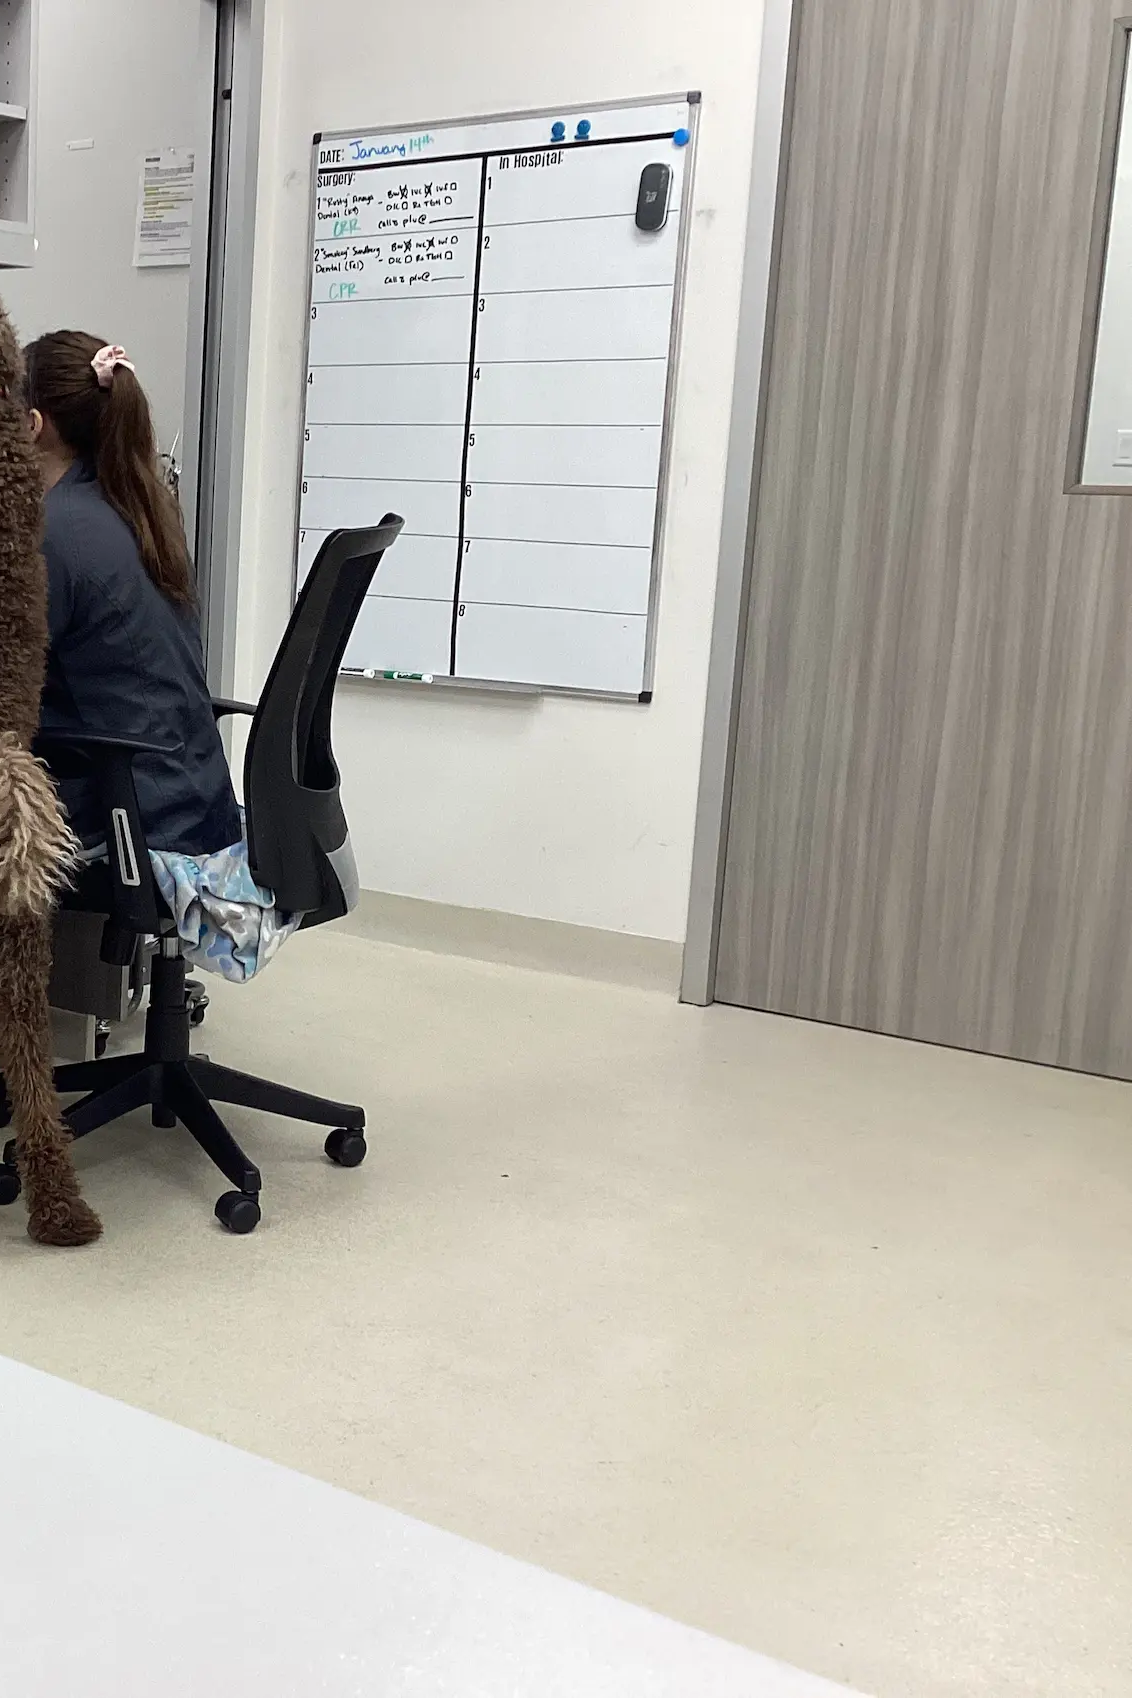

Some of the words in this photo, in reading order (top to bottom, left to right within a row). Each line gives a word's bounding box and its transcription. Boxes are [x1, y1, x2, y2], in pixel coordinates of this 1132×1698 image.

[349, 139, 406, 160] January
[320, 149, 345, 164] DATE:
[499, 155, 509, 170] In
[514, 151, 564, 169] Hospital:
[487, 176, 492, 190] 1
[317, 197, 321, 210] 1
[484, 236, 490, 249] 2
[314, 248, 320, 262] 2
[315, 262, 341, 273] Dental
[328, 282, 359, 300] CPR
[479, 299, 485, 312] 3
[311, 306, 317, 320] 3
[307, 372, 313, 385] 4
[474, 367, 481, 380] 4
[304, 429, 310, 442] 5
[469, 434, 475, 447] 5
[302, 482, 308, 495] 6
[465, 484, 472, 497] 6
[300, 530, 306, 543] 7
[465, 540, 471, 553] 7
[458, 604, 465, 617] 8
